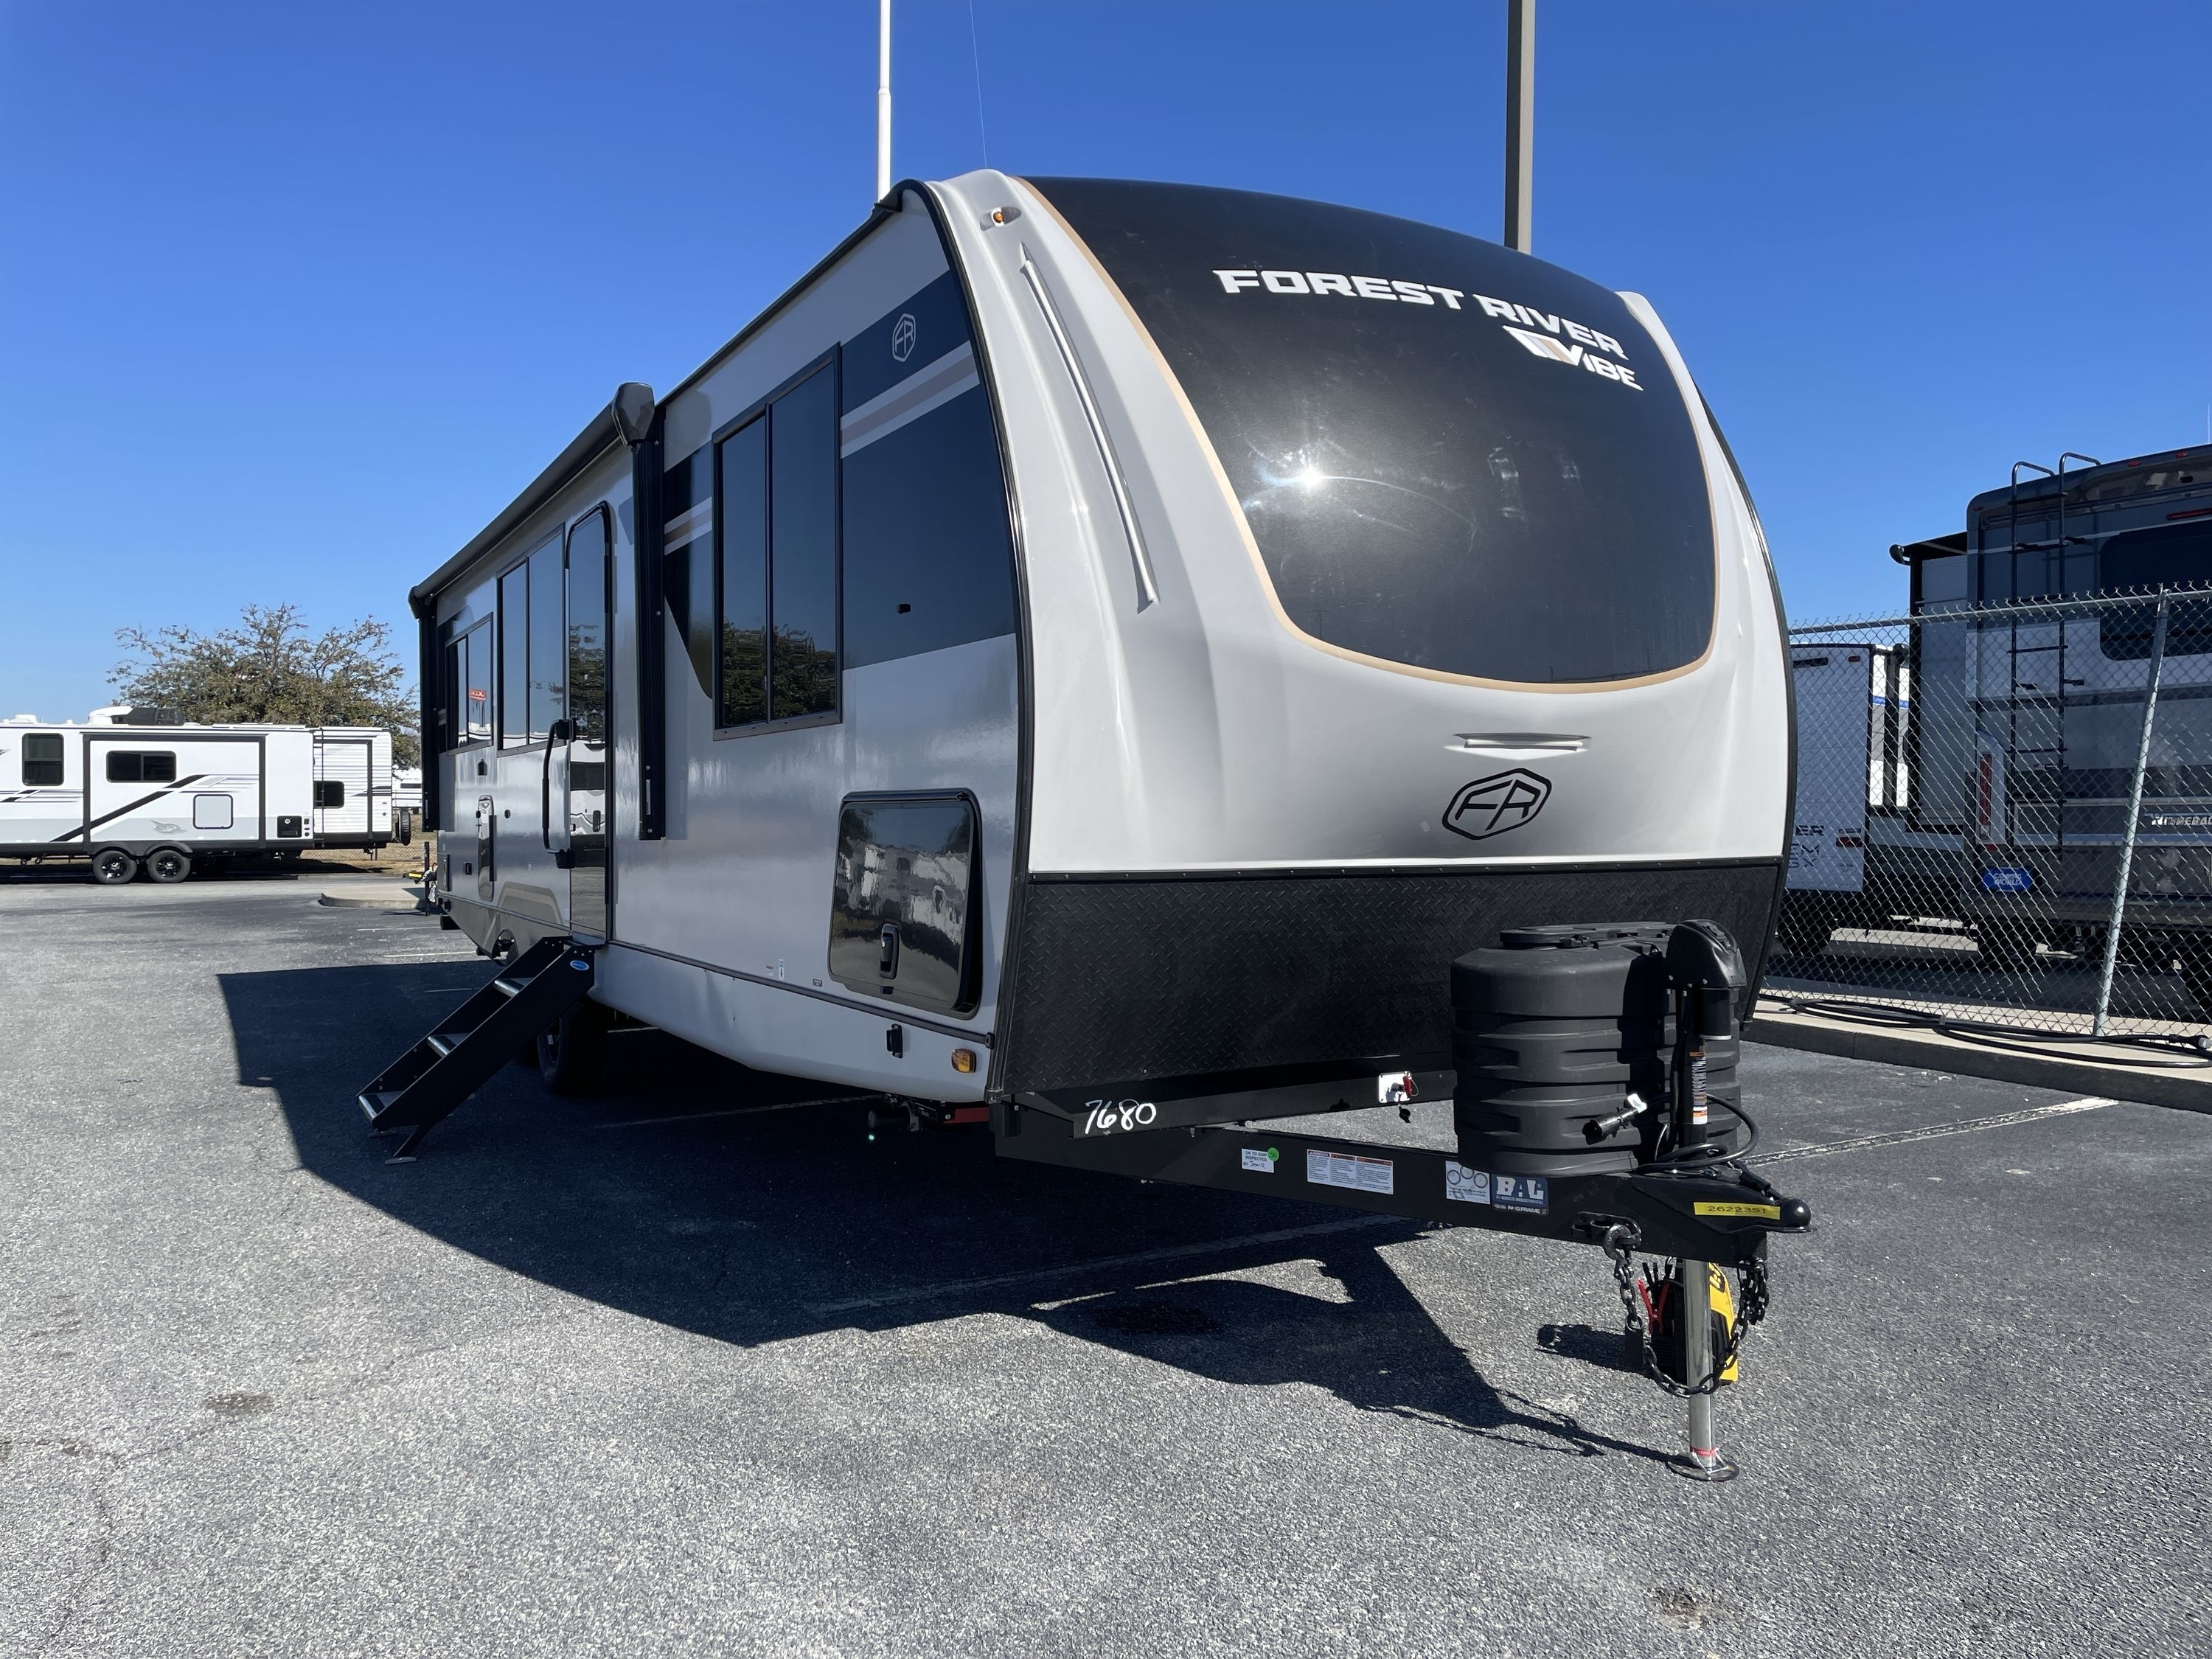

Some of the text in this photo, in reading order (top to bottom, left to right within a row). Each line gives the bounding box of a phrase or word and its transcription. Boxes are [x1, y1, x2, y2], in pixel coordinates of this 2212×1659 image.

[1212, 270, 1630, 361] FOREST RIVER
[1502, 324, 1644, 392] VIBE
[1085, 1099, 1156, 1134] 7680
[1496, 1176, 1545, 1200] BAL
[1707, 1206, 1767, 1214] 2622351
